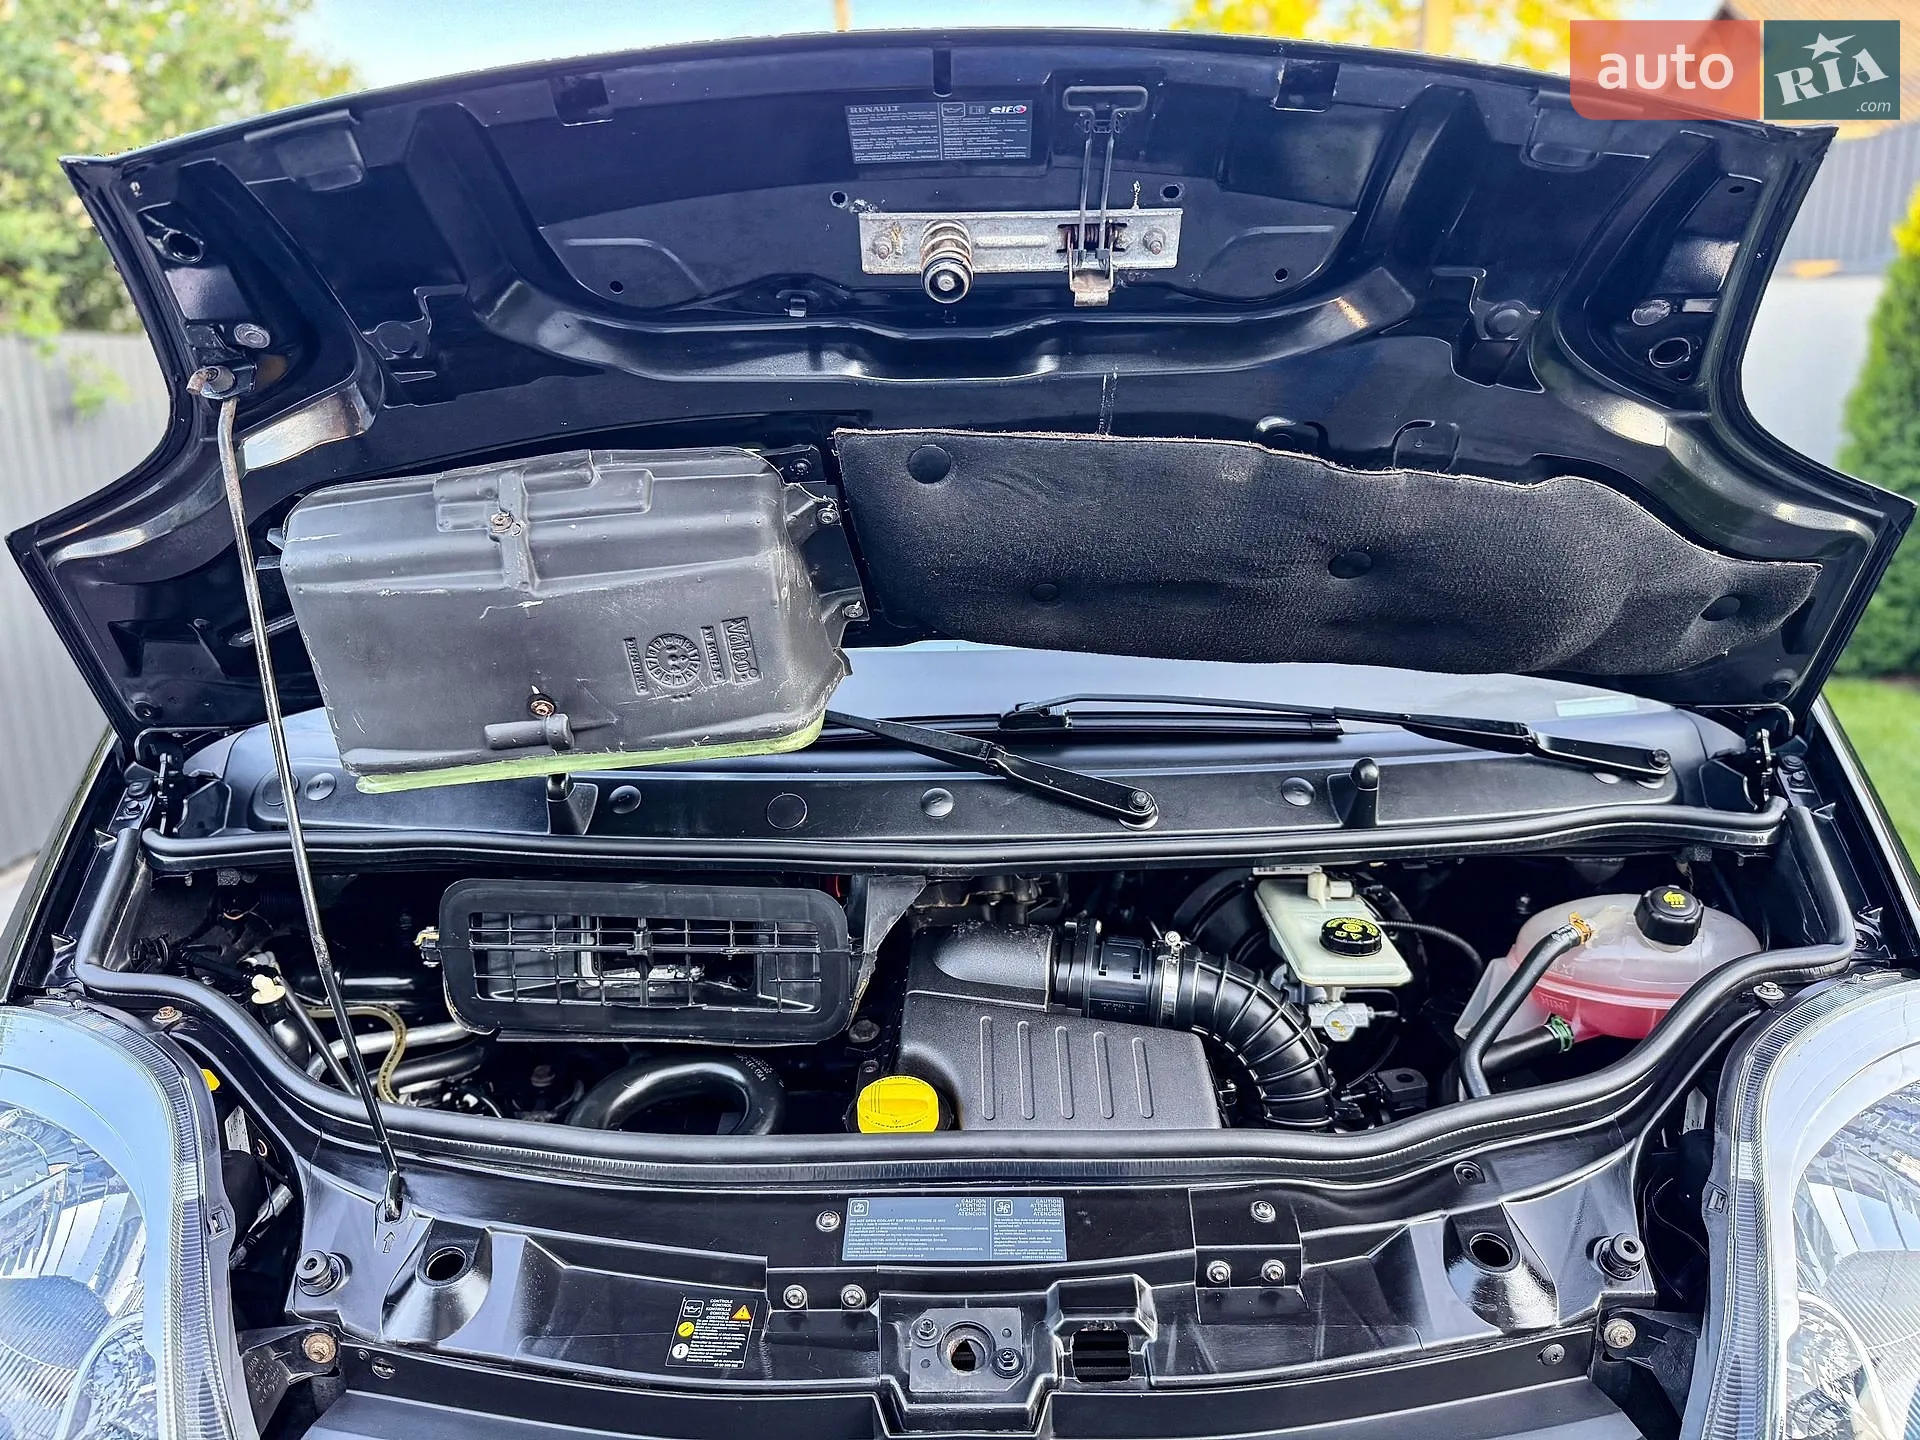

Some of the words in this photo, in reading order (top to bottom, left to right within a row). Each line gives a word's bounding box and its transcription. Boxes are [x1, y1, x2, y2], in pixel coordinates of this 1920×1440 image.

[850, 105, 900, 113] RENAULT
[990, 106, 1014, 114] elf
[727, 619, 751, 673] Valeo
